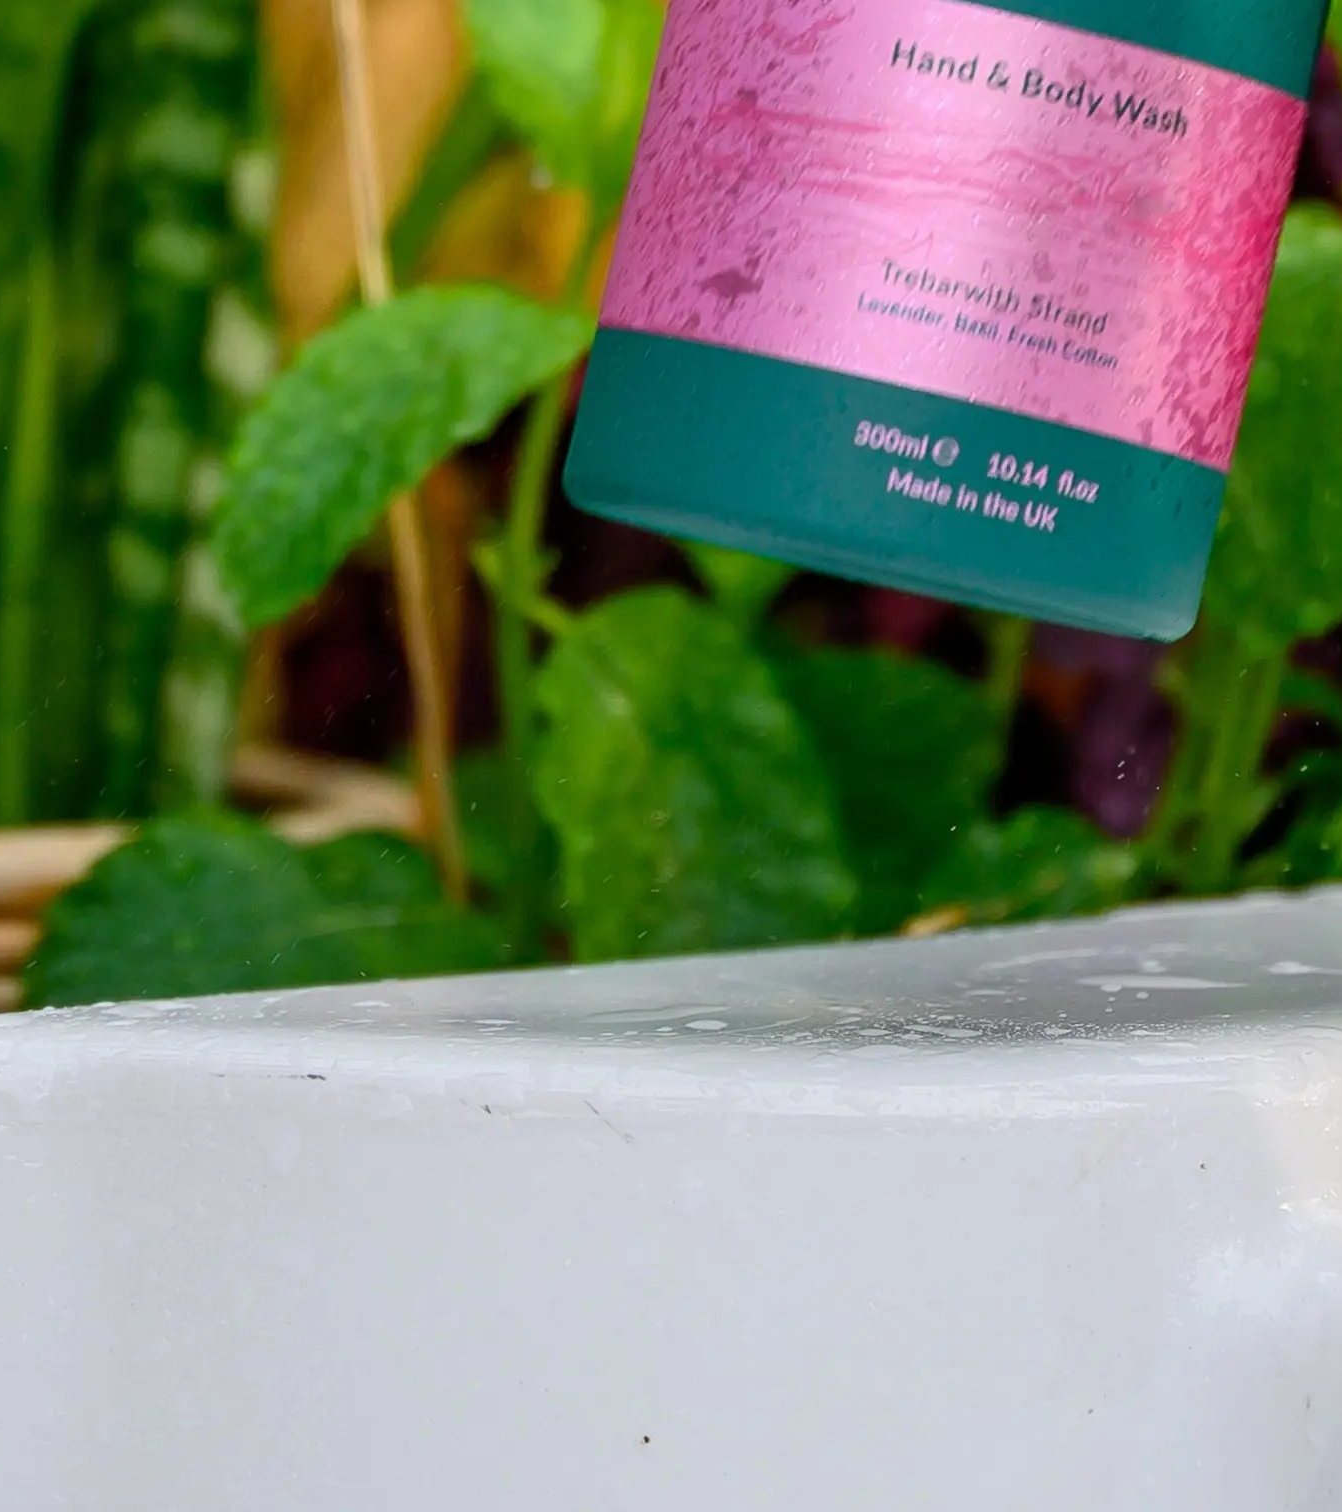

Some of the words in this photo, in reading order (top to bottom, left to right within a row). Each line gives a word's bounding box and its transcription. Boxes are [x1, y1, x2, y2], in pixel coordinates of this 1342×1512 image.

[890, 38, 979, 83] Hand
[987, 61, 1009, 91] &
[1021, 68, 1104, 118] Body
[1113, 90, 1188, 137] Wash
[882, 257, 1021, 313] Trebarwith
[1031, 293, 1109, 335] Strand
[887, 466, 952, 506] Made
[955, 483, 978, 512] in
[983, 491, 1020, 523] the
[1024, 500, 1059, 533] UK
[987, 452, 1049, 491] 10.14
